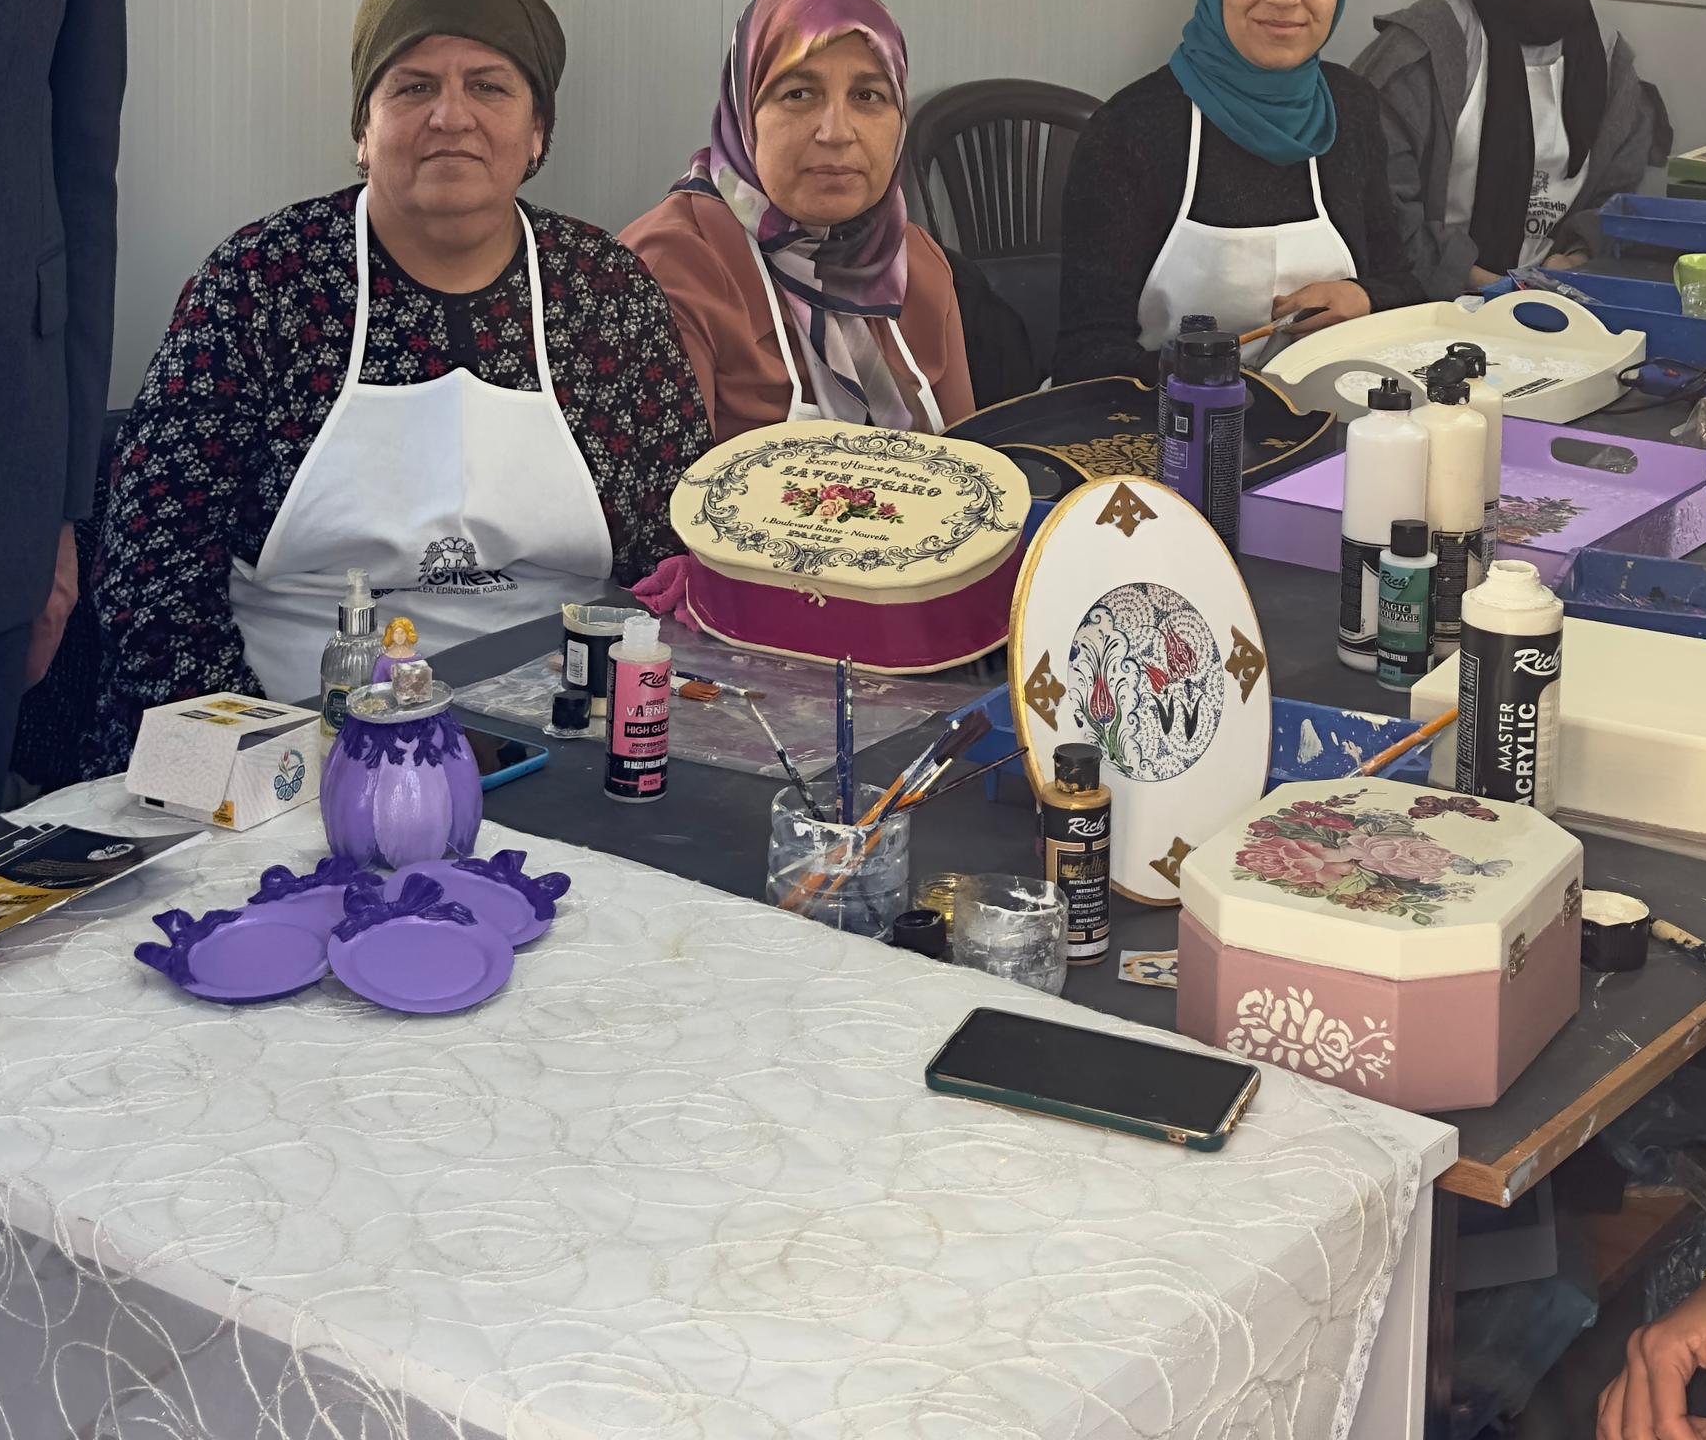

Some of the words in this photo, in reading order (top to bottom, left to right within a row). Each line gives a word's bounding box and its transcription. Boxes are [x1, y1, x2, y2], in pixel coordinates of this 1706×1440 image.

[814, 523, 844, 535] Bonne
[850, 529, 891, 543] Nouvelle
[436, 586, 482, 595] EDİNDİRME
[482, 582, 519, 594] KURSLARI
[1379, 569, 1411, 590] Rich
[1379, 609, 1420, 623] COUPAGE
[1512, 643, 1562, 677] Rich
[638, 664, 670, 689] Rich
[626, 704, 669, 718] VARNIS
[626, 725, 650, 736] HIGH
[651, 721, 669, 734] GLO
[1497, 702, 1515, 772] MASTER
[1514, 703, 1537, 808] ACRYLIC
[1068, 813, 1107, 837] Rich
